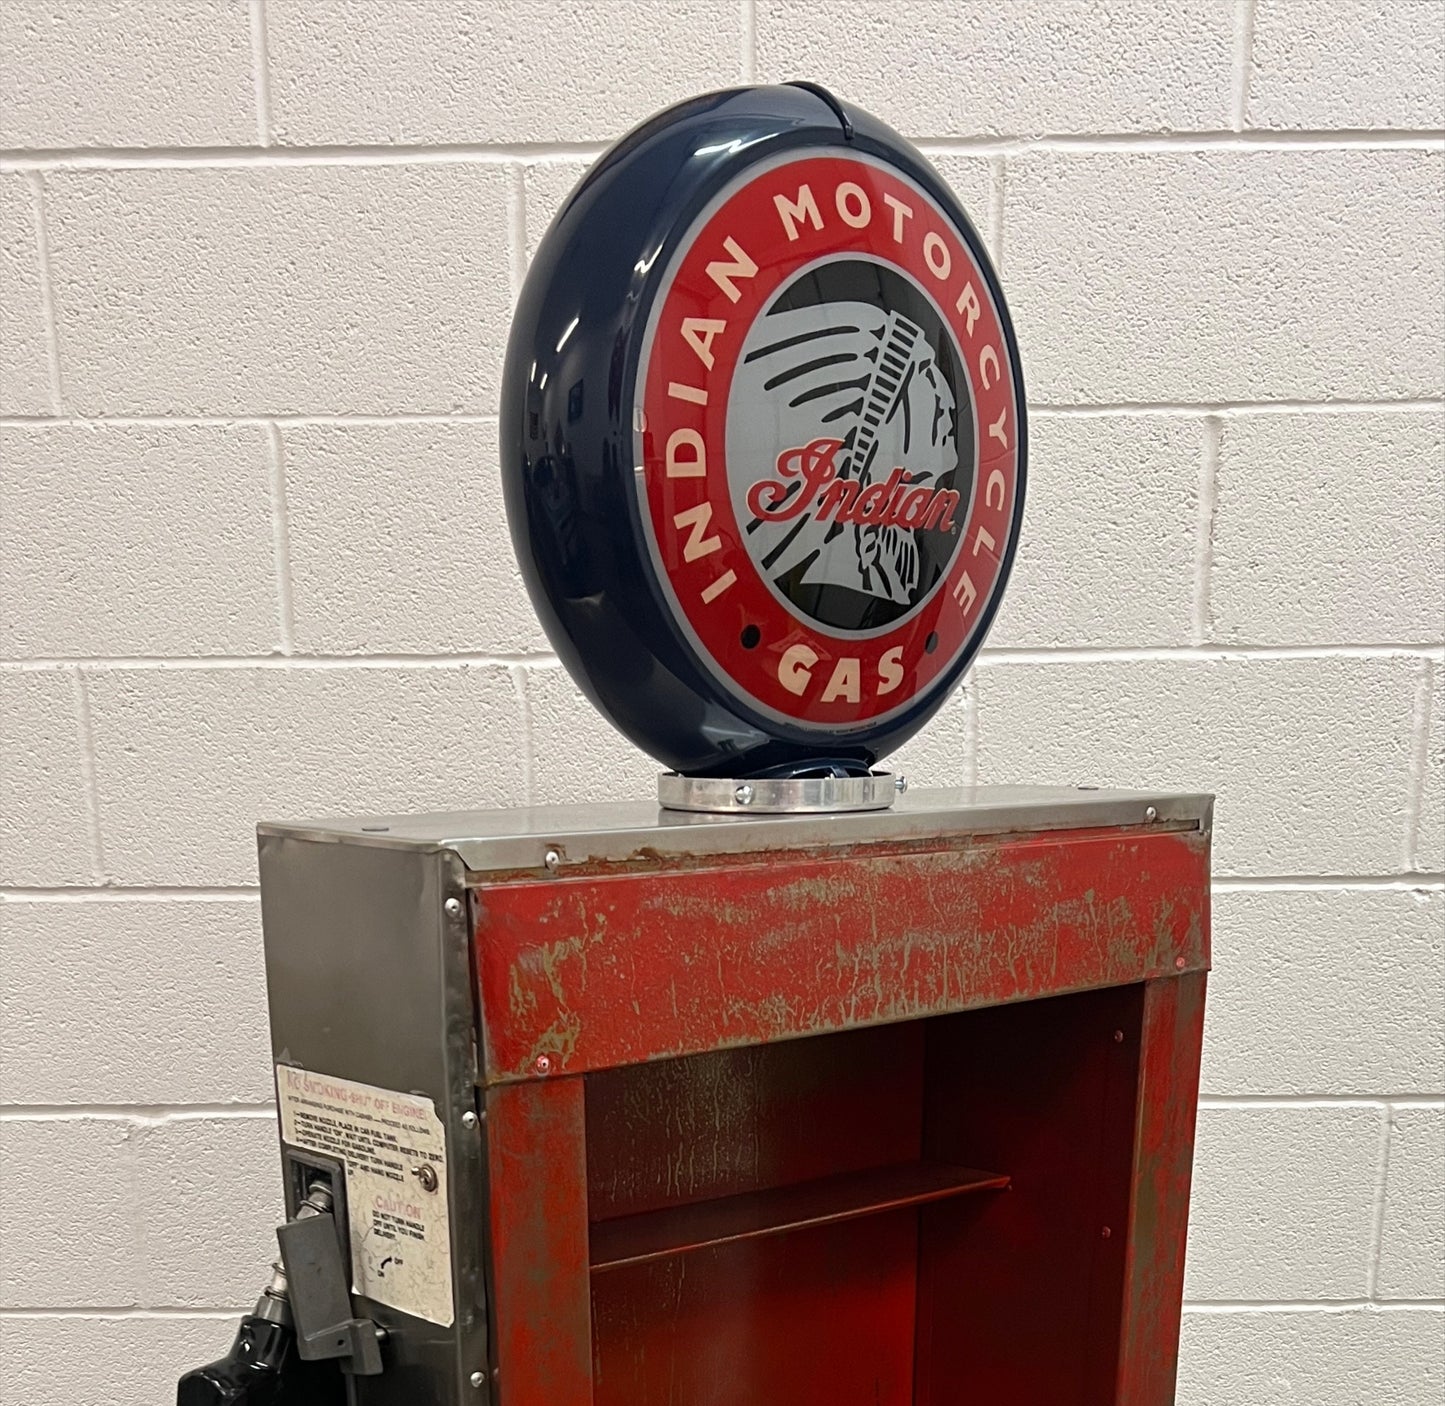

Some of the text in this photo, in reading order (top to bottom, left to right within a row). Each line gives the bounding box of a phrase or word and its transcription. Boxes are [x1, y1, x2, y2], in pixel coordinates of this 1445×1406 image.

[665, 181, 1007, 613] INDIAN MOTORCYCLE
[746, 437, 960, 532] Indian
[778, 643, 905, 703] GAS
